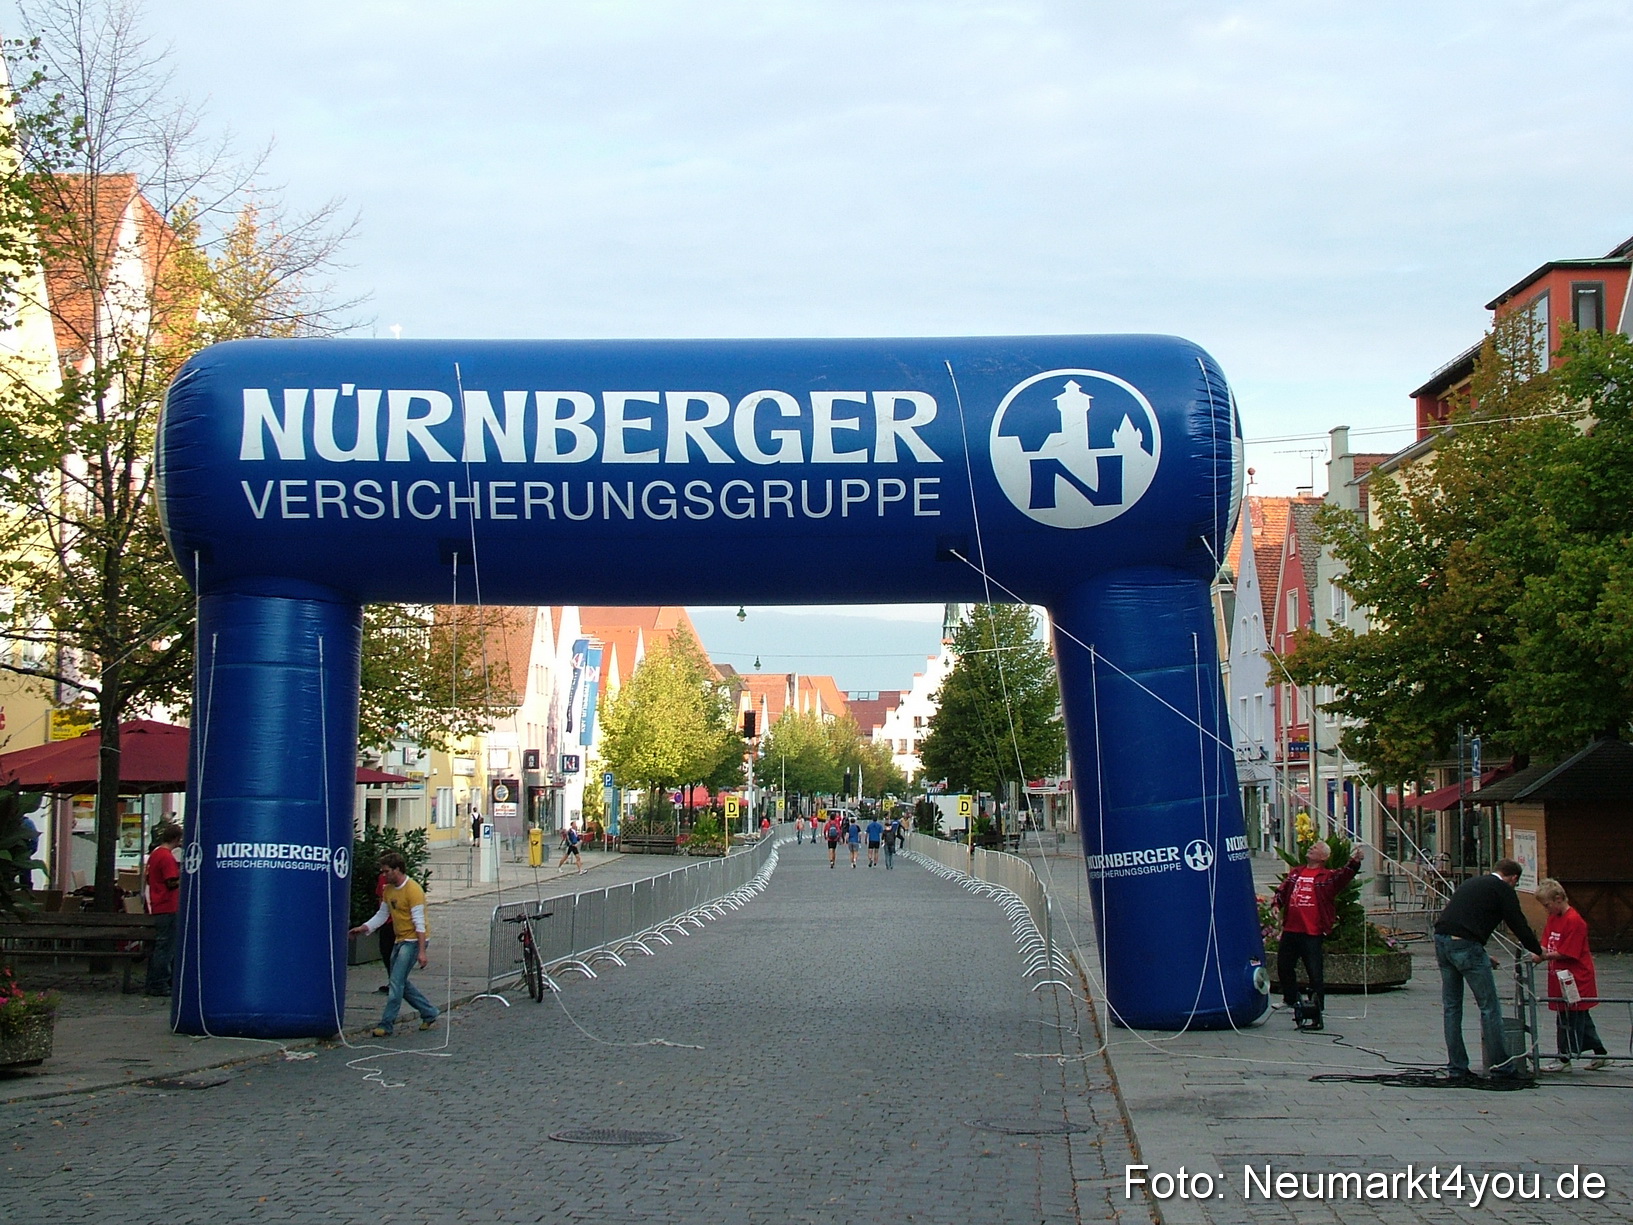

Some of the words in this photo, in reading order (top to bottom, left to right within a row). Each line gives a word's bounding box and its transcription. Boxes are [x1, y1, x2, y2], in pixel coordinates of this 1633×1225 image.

[239, 383, 944, 465] NÜRNBERGER
[241, 477, 941, 520] VERSICHERUNGSGRUPPE
[728, 802, 736, 813] D
[961, 801, 969, 812] D
[216, 842, 332, 862] NÜRNBERGER
[1087, 846, 1180, 870] NÜRNBERGER
[216, 860, 331, 873] VERSICHERUNGSGRUPPE
